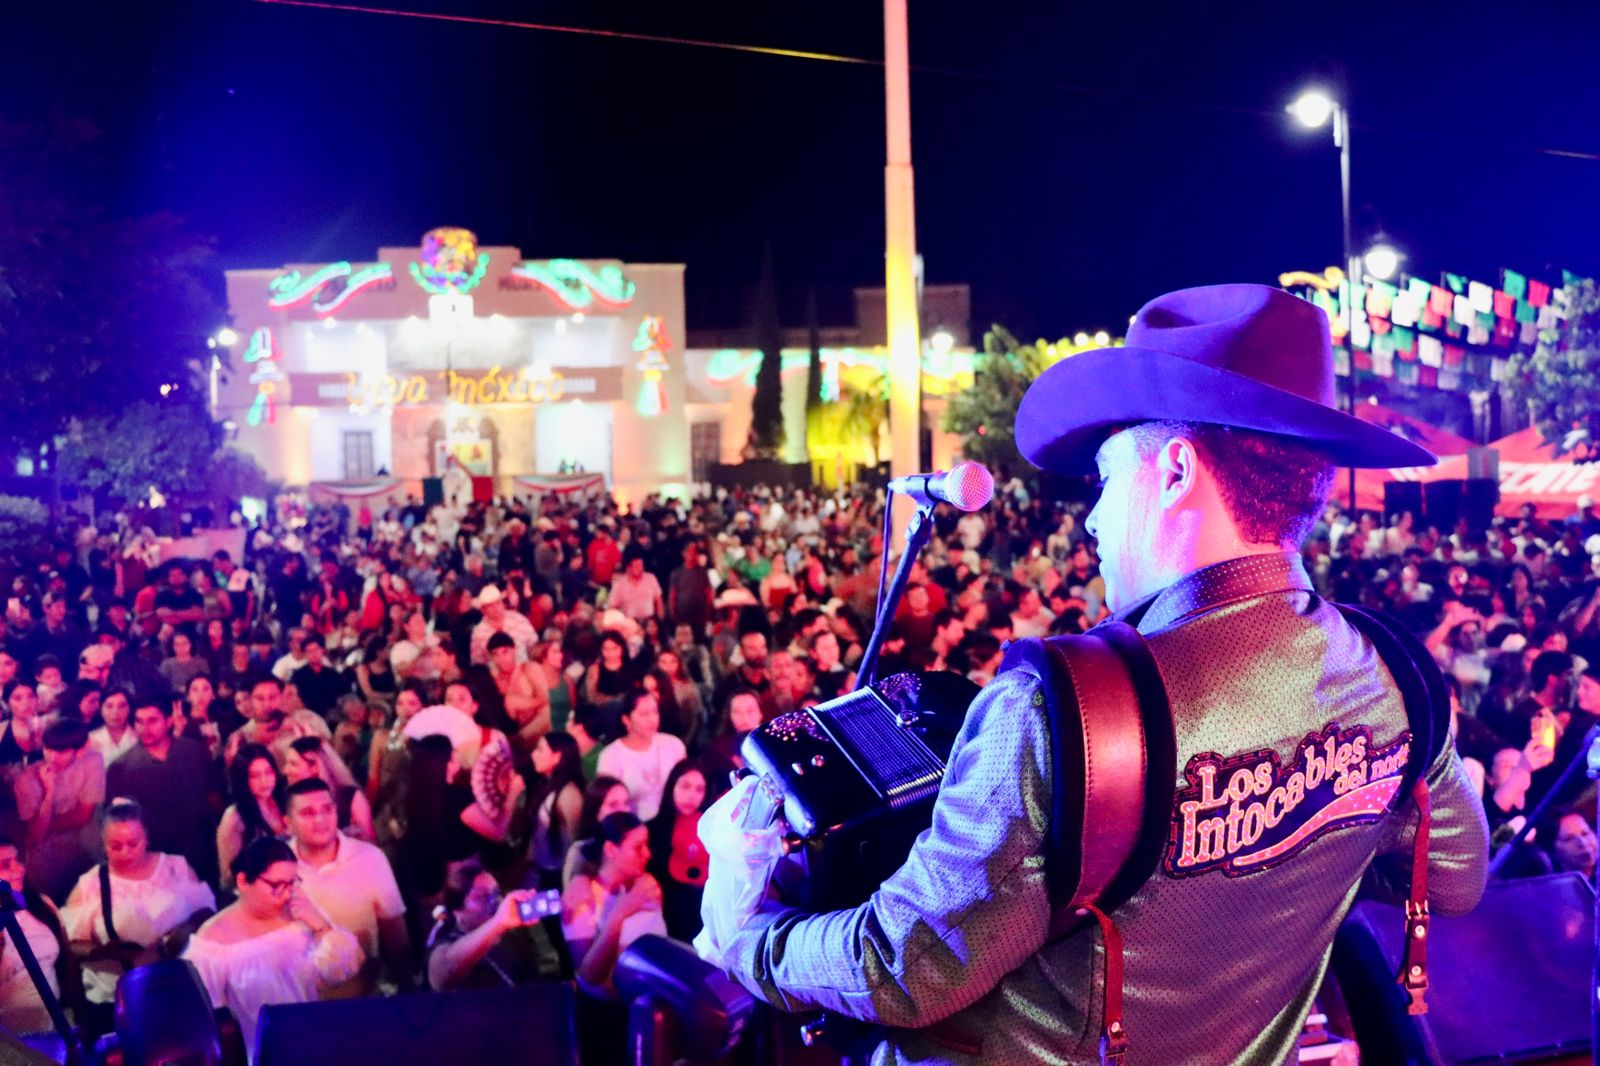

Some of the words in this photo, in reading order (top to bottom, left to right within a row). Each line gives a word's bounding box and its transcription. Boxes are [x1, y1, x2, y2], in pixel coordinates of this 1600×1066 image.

[1177, 735, 1367, 867] Intocables
[1199, 761, 1273, 810] Los
[1333, 760, 1368, 795] del
